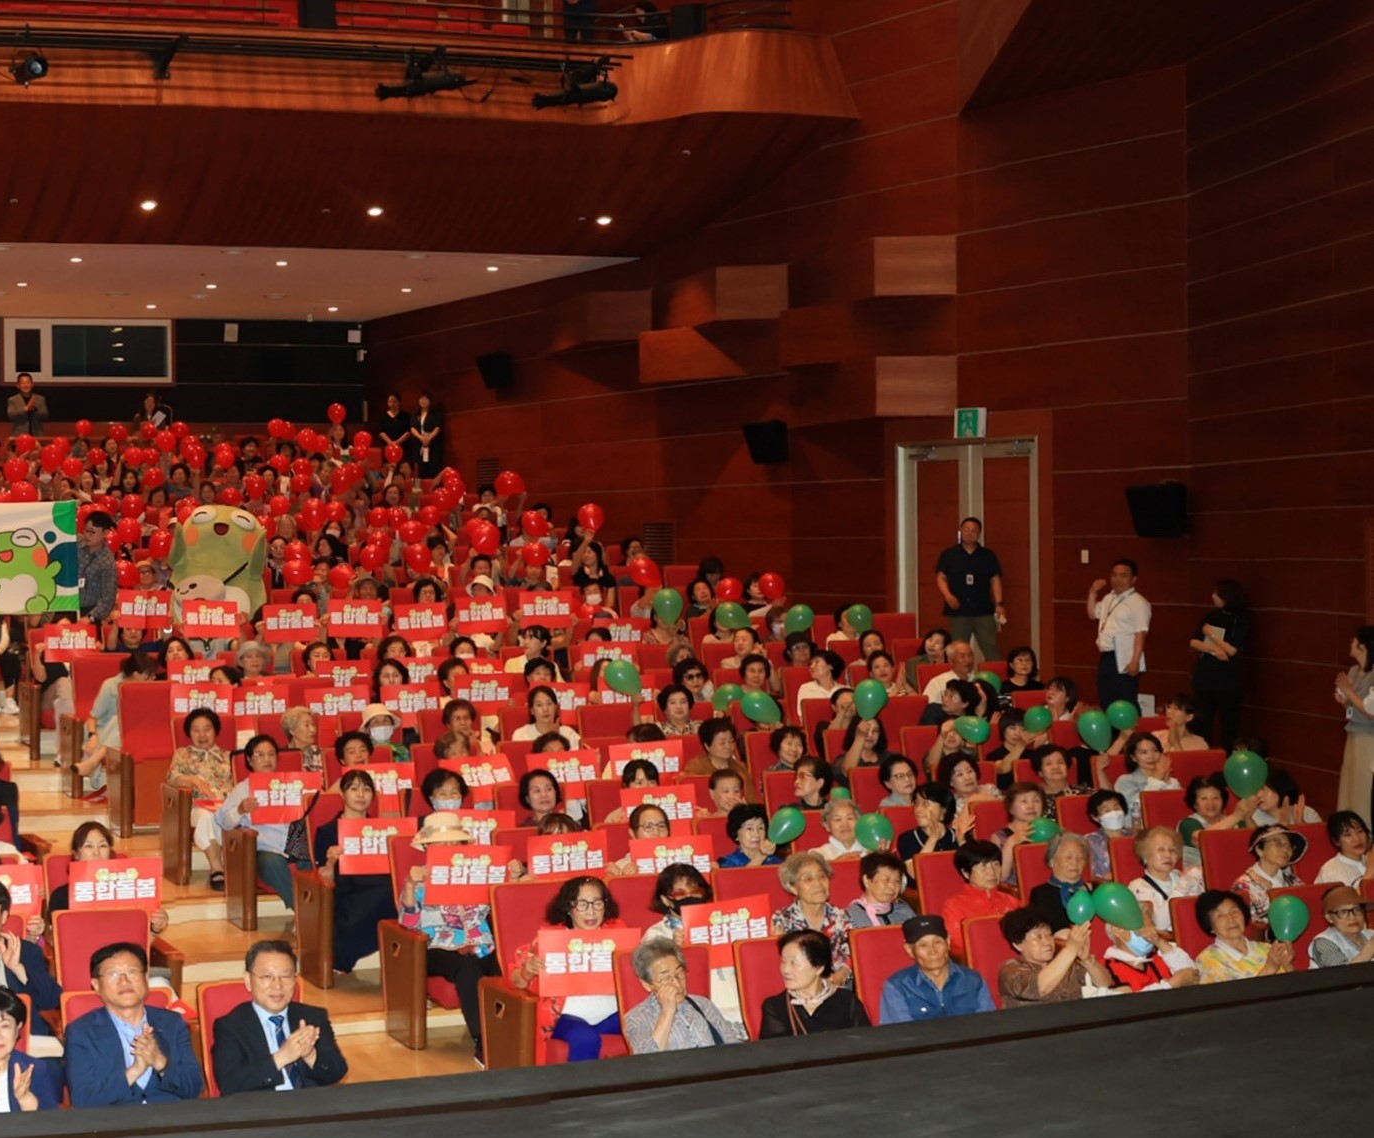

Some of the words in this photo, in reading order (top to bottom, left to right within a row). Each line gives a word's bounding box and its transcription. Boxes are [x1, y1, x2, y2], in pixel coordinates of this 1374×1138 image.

[532, 849, 605, 875] 통합돌봄
[431, 864, 507, 885] 통합돌봄
[74, 878, 156, 902] 통합돌봄
[689, 917, 768, 946] 통합돌봄
[545, 951, 614, 974] 통합돌
